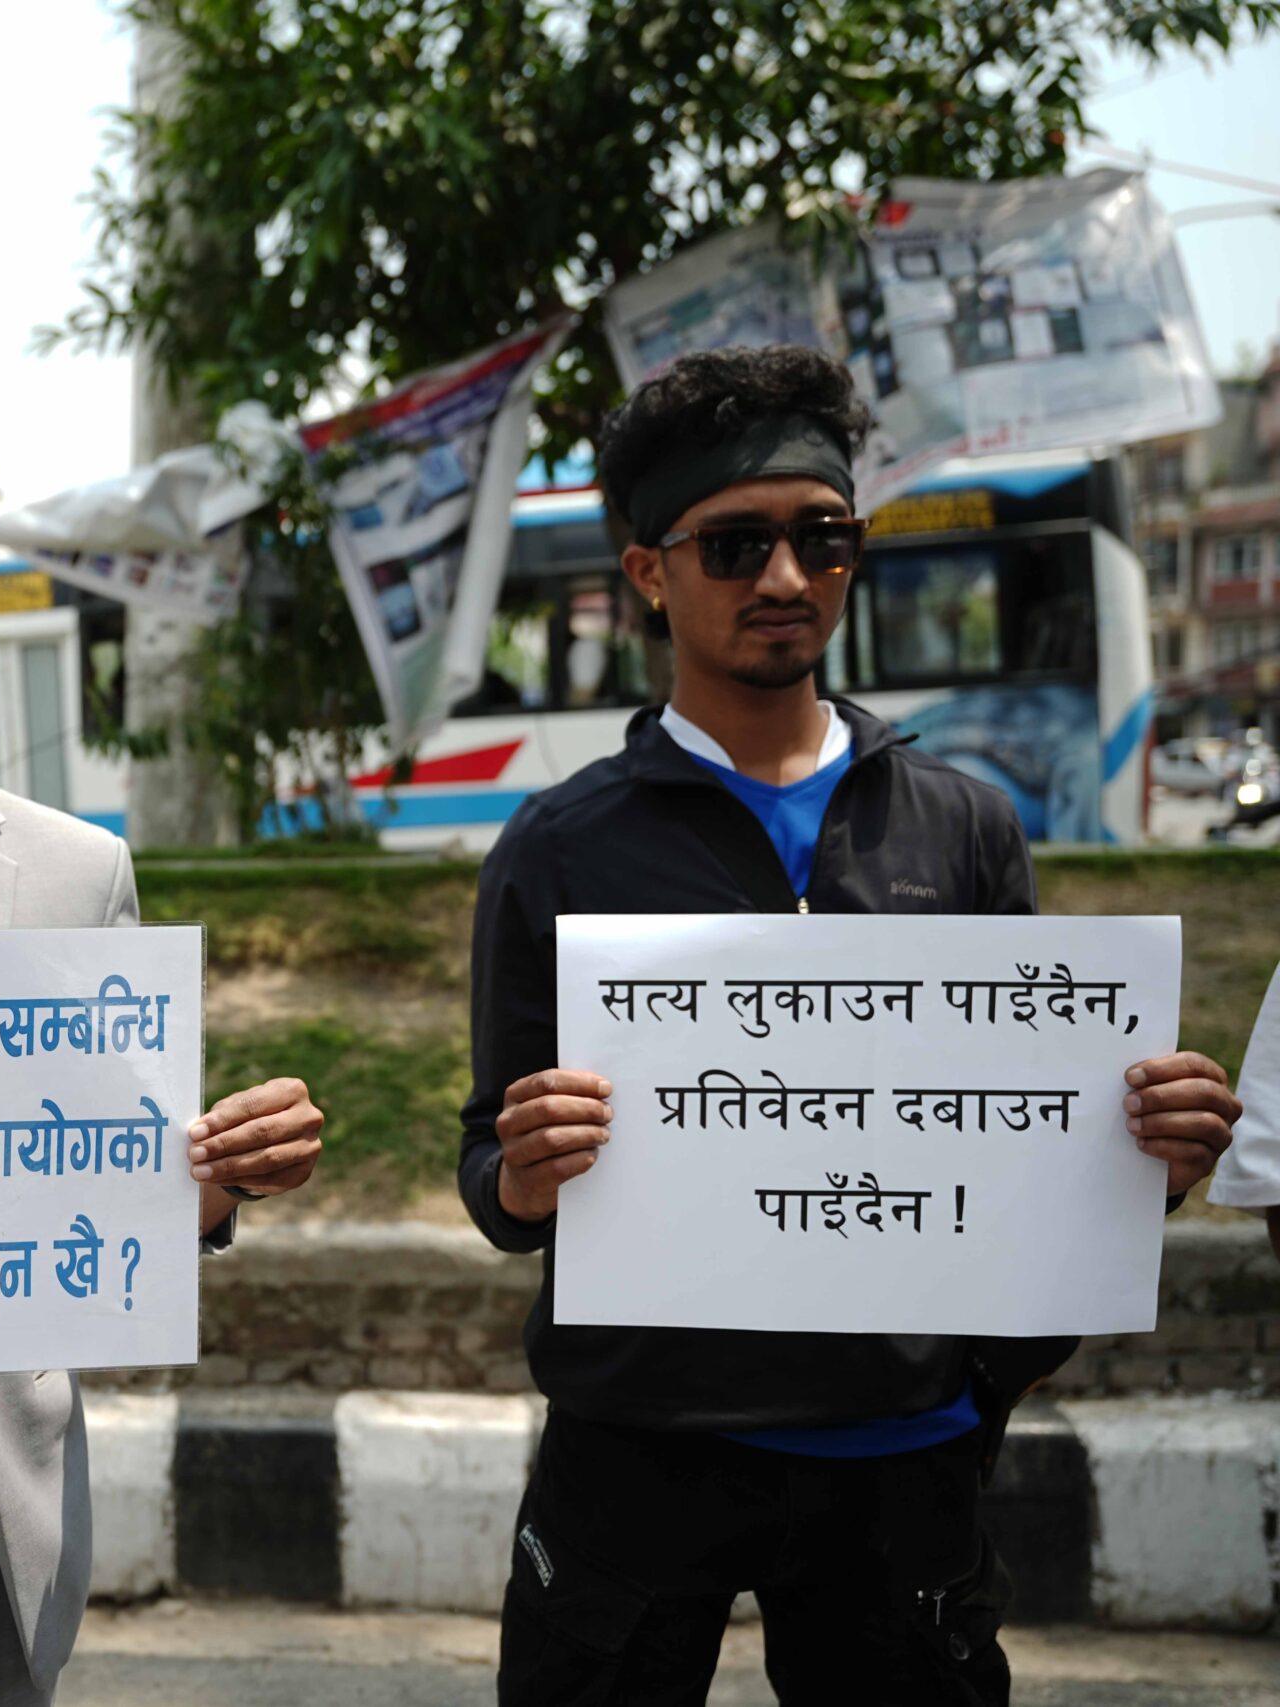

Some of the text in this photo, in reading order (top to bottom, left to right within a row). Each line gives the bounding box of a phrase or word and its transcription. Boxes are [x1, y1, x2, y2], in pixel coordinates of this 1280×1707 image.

[598, 963, 1139, 1038] सत्य लुकाउन पाइँदैन,
[654, 1069, 1080, 1133] प्रतिवेदन दबाउन
[754, 1171, 966, 1239] पाइँदैन !
[53, 1213, 105, 1298] खै
[121, 1236, 142, 1311] ?
